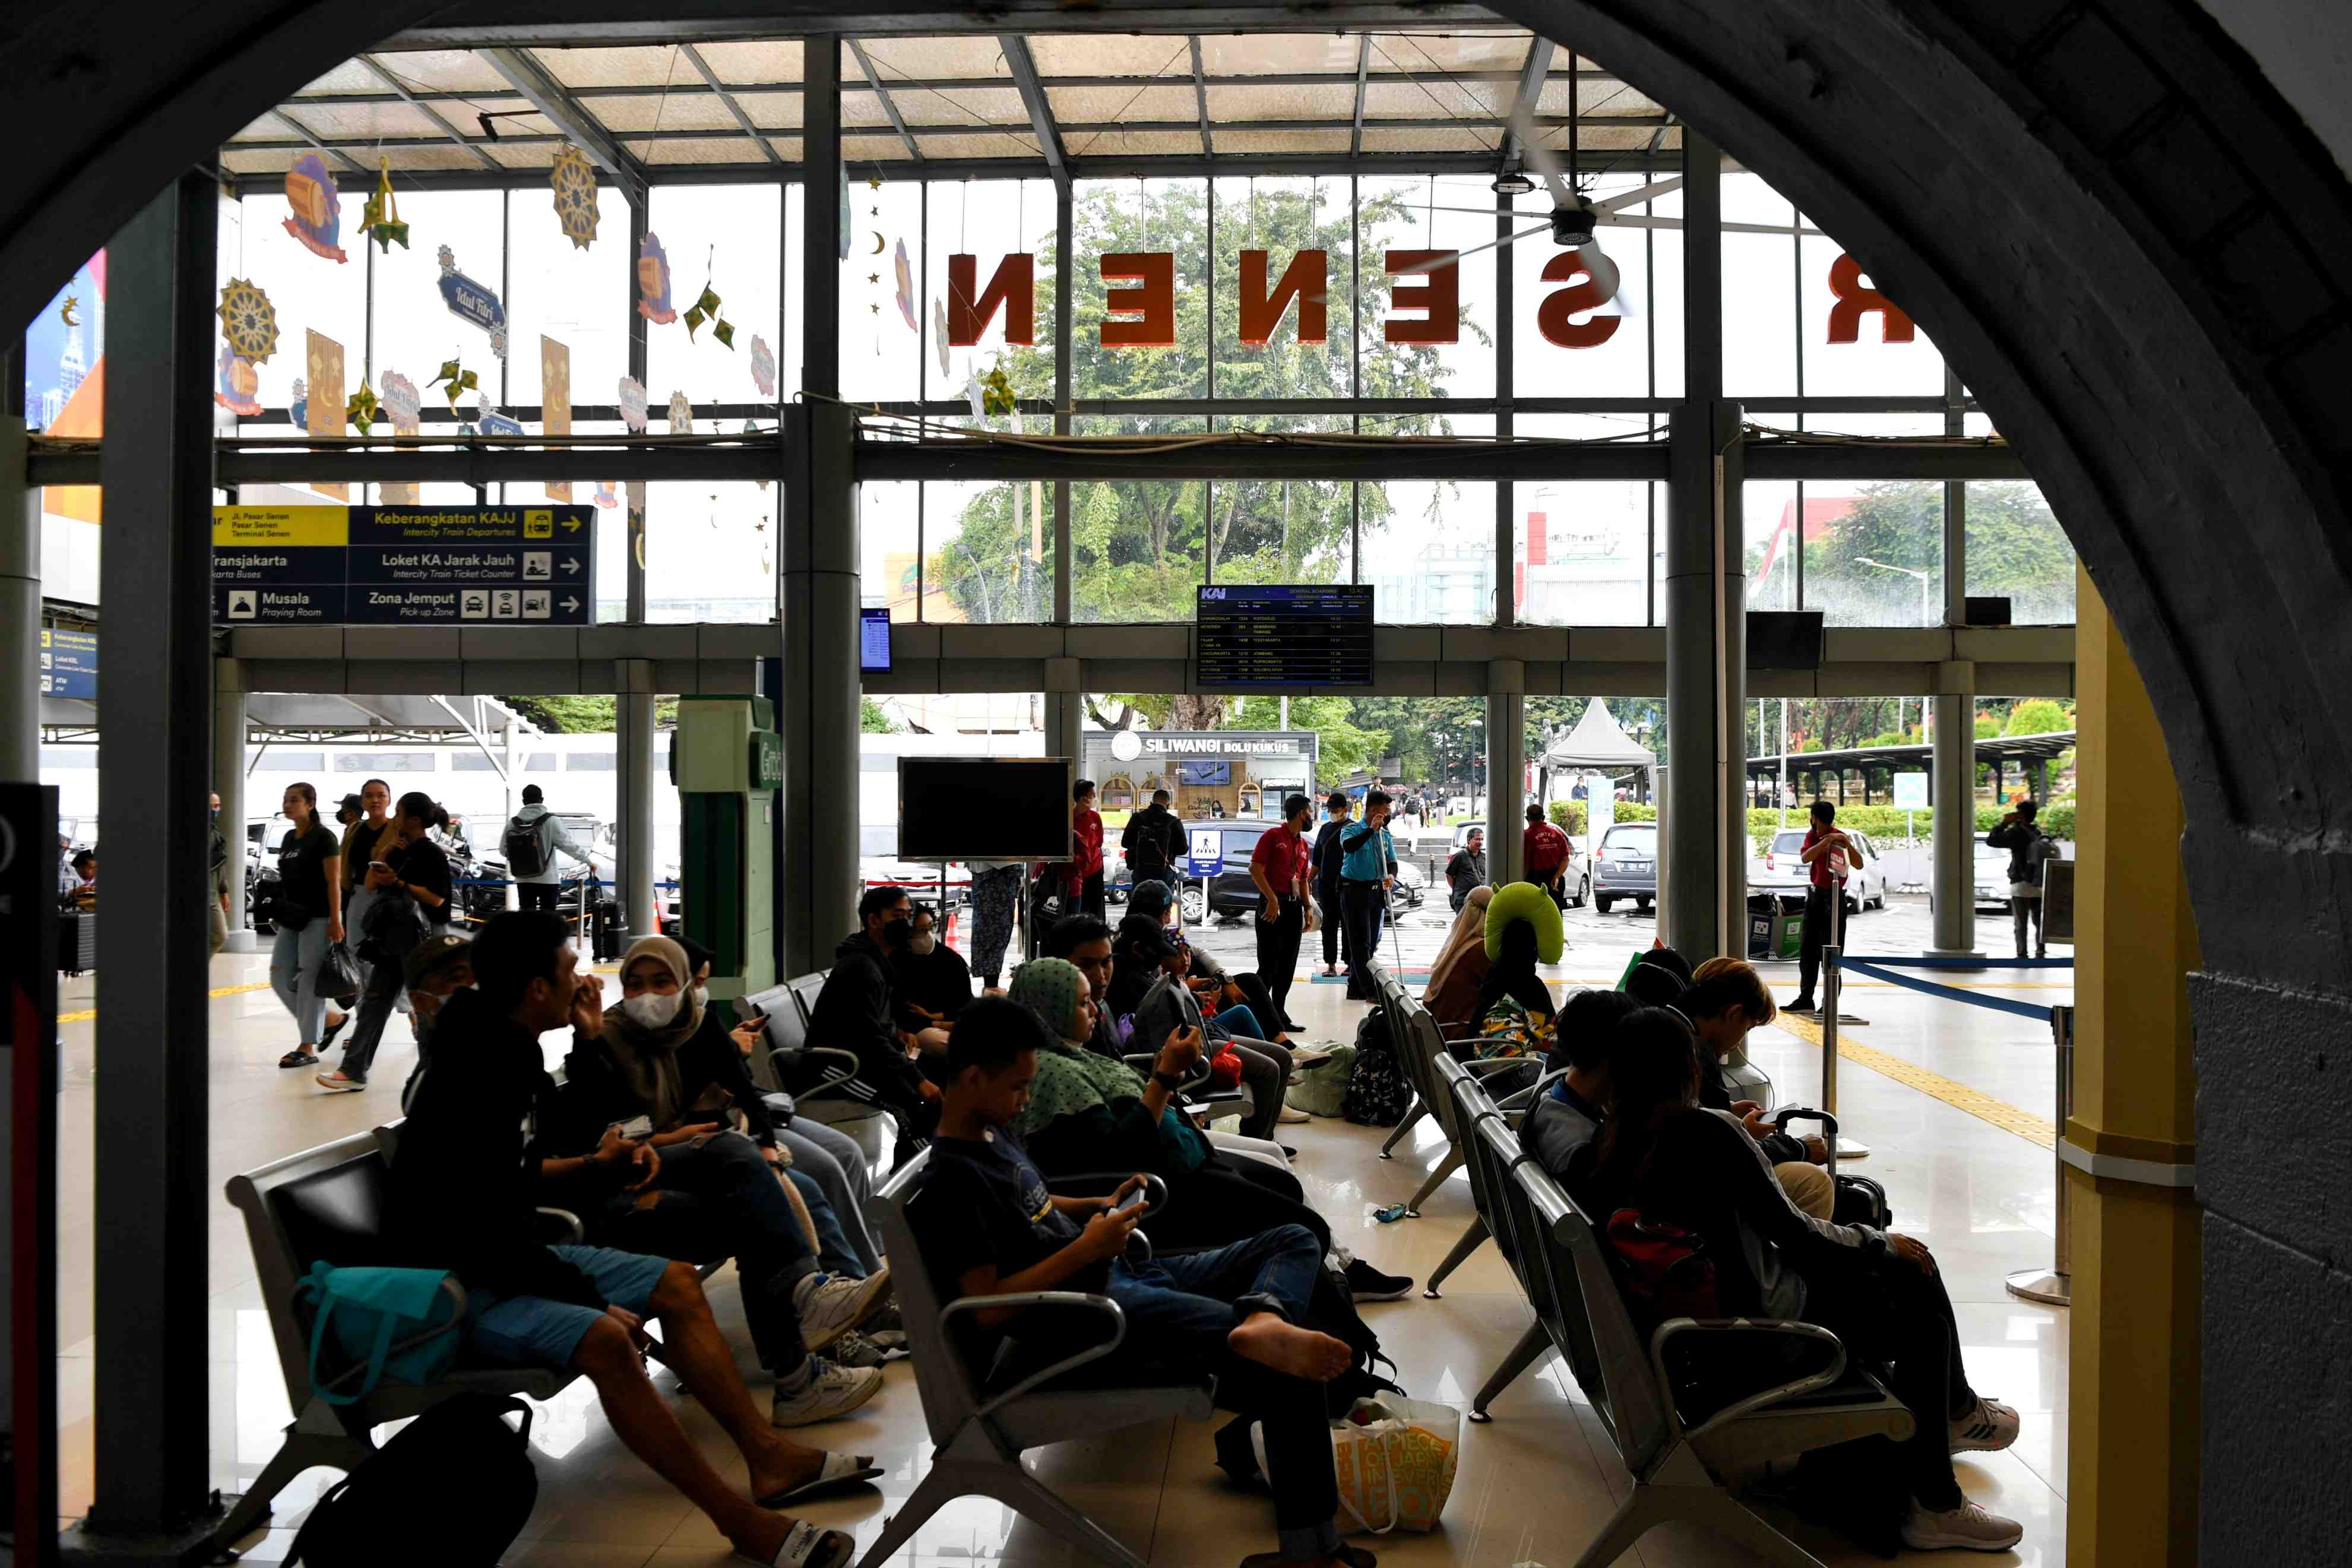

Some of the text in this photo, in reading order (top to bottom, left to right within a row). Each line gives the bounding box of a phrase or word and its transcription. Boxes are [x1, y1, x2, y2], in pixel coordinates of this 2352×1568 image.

[456, 287, 475, 310] Idul
[476, 298, 493, 321] Fitri
[375, 512, 516, 526] Keberangkatan KAJJ
[403, 528, 516, 537] Intercity Train Departures
[382, 554, 515, 566] Loket KA Jarak Jauh
[236, 570, 261, 578] Buses
[393, 569, 515, 578] Intercity Train Ticket Counter
[262, 592, 310, 604] Musala
[369, 592, 455, 606] Zona Jemput
[1201, 588, 1226, 599] KAI
[262, 607, 322, 617] Praying Room
[400, 607, 455, 617] Pick-up Zone
[1146, 739, 1290, 753] SILIWANGI BOLU KUKUS
[1386, 1433, 1442, 1452] PIECE
